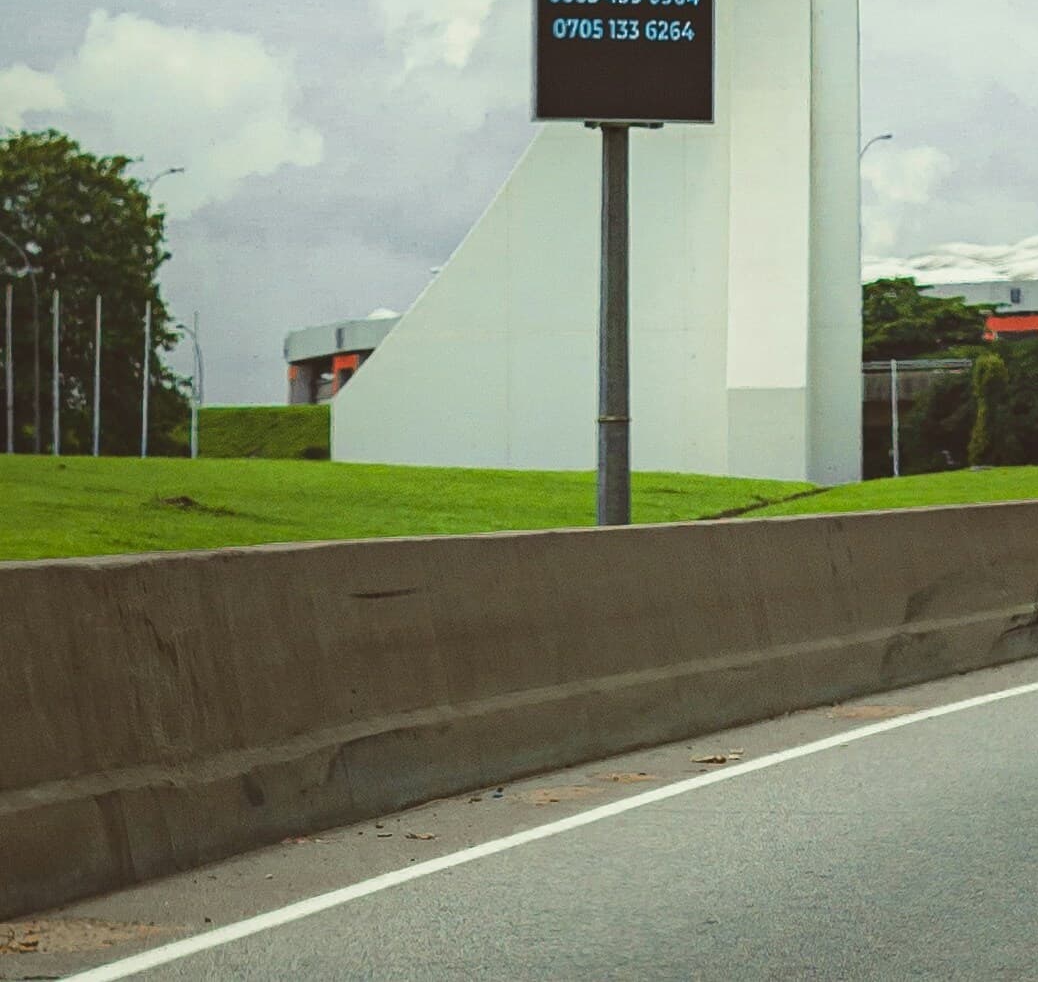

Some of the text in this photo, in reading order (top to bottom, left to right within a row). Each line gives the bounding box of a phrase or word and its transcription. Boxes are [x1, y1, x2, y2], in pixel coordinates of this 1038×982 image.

[553, 18, 695, 41] 0705 133 6264
